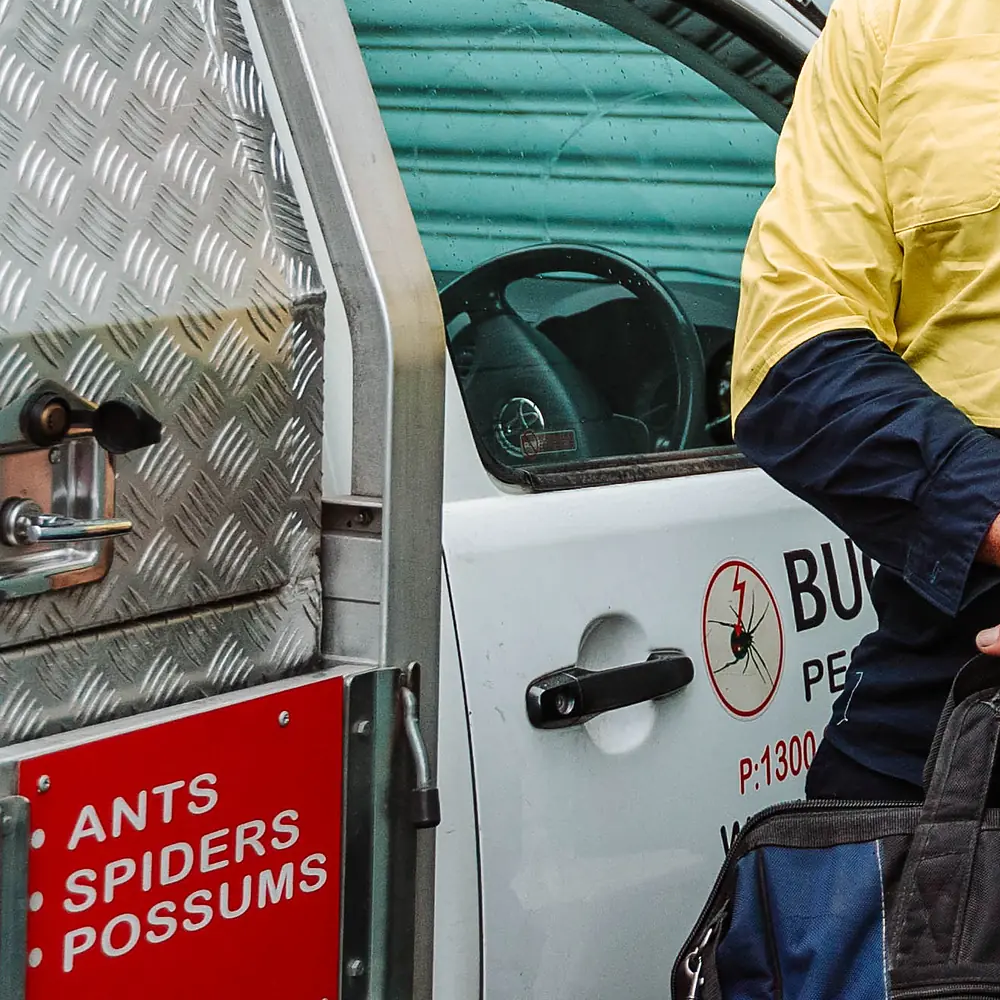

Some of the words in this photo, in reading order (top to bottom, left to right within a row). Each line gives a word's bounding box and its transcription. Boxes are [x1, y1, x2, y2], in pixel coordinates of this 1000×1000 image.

[739, 730, 816, 795] P:1300
[67, 773, 219, 850] ANTS
[63, 809, 300, 914] SPIDERS
[62, 852, 328, 973] POSSUMS
